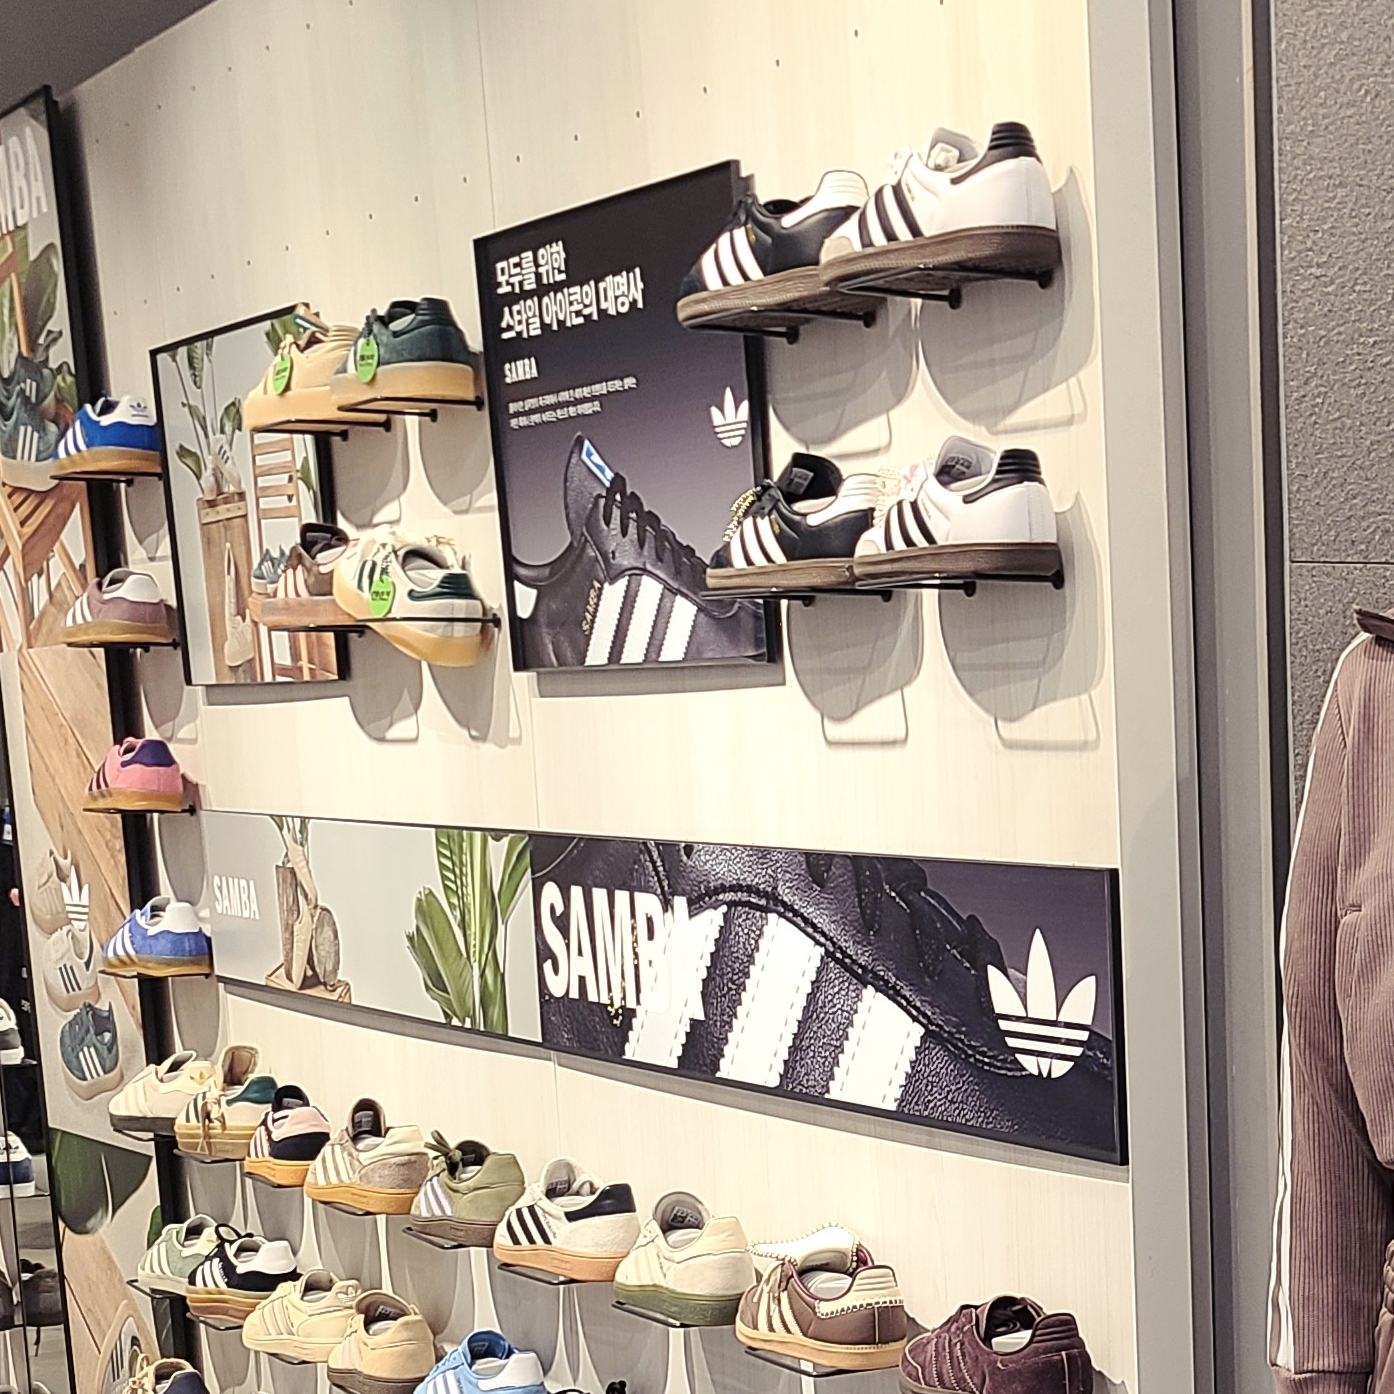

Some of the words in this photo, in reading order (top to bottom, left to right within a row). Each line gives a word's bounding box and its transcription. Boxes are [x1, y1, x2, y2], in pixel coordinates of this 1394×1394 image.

[495, 250, 537, 294] 모두를
[537, 240, 566, 285] 위한
[500, 295, 542, 340] 스타일
[541, 279, 598, 331] 아이콘의
[598, 266, 644, 316] 대명사
[503, 356, 539, 385] SAMBA
[213, 874, 260, 920] SAMBA
